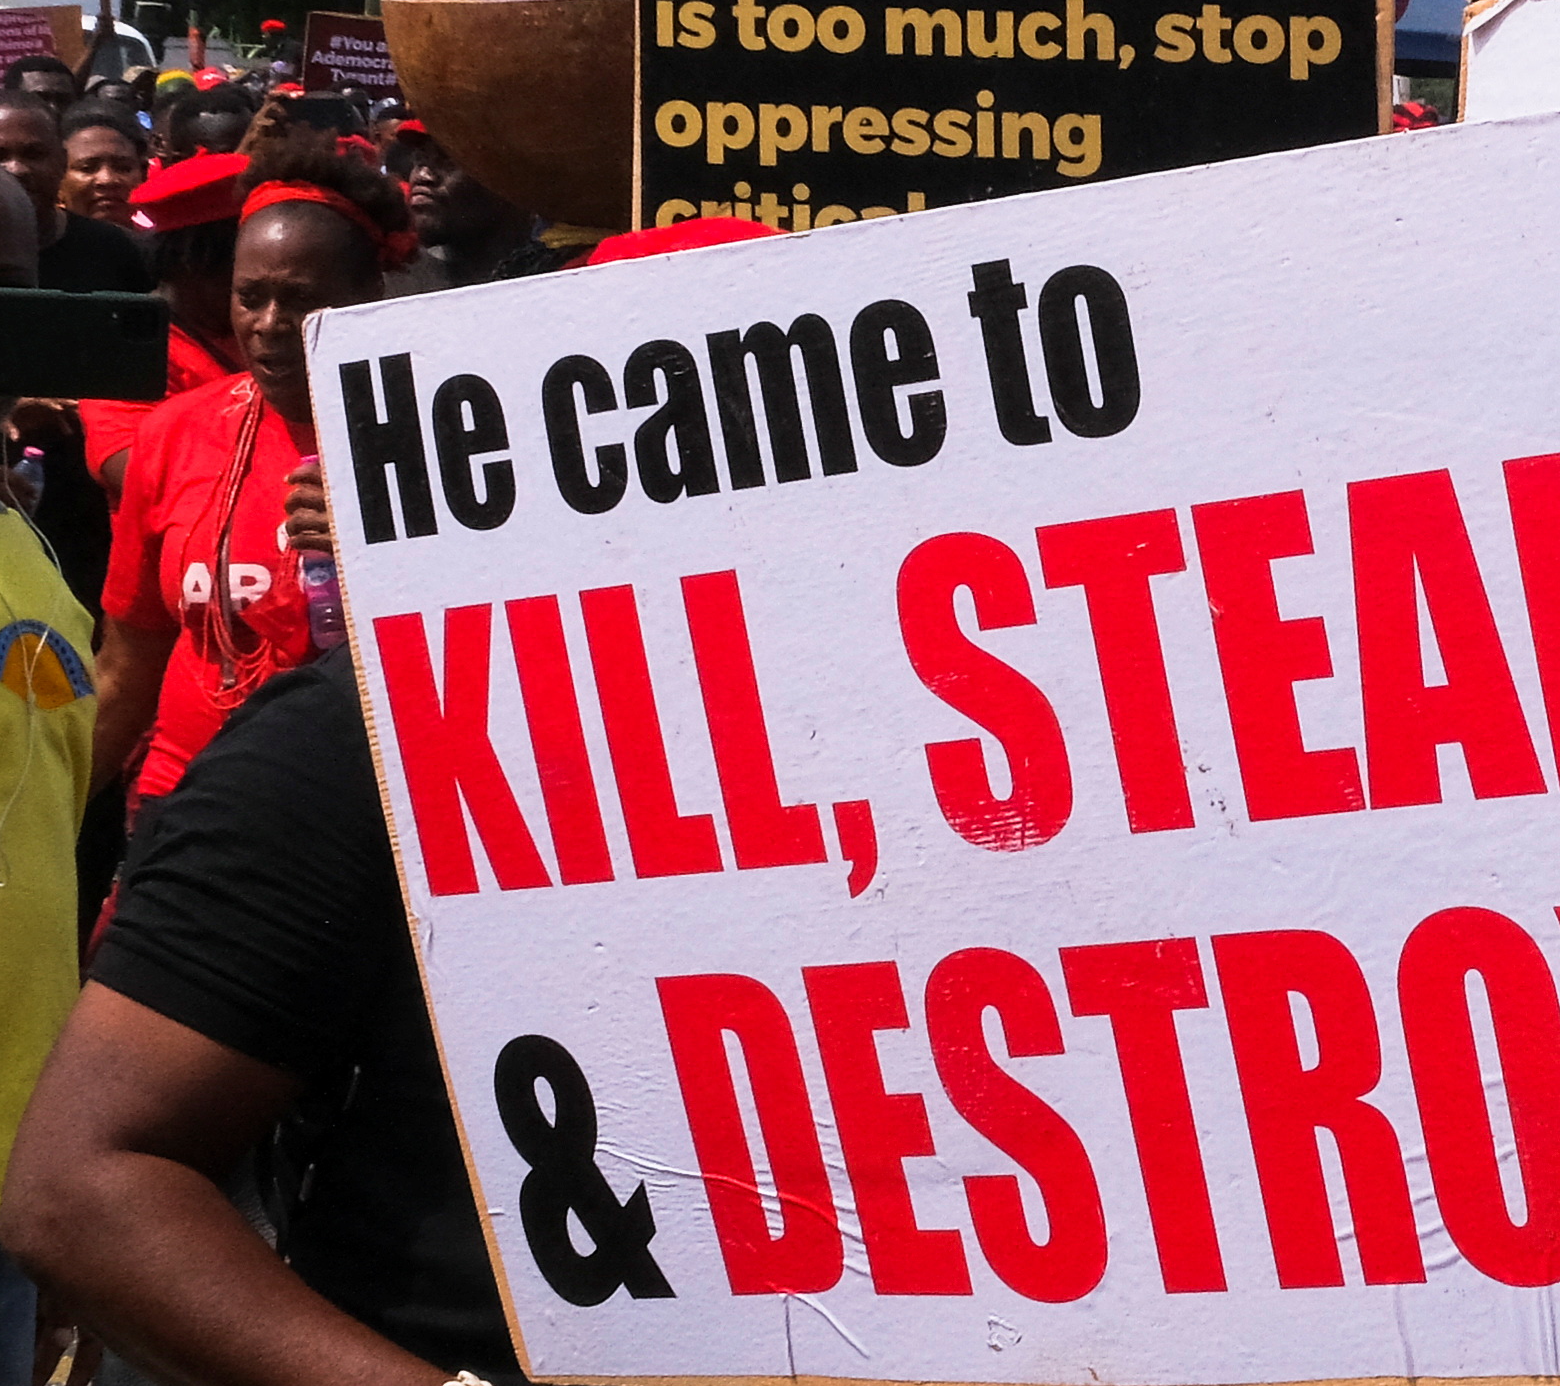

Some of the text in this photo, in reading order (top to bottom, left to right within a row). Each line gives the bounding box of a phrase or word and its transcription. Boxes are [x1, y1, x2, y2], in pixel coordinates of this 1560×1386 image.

[655, 90, 1102, 177] oppressing
[1154, 5, 1341, 80] stop
[655, 180, 927, 232] citic
[339, 259, 1140, 544] He came to
[373, 570, 877, 897] KILL,
[486, 1035, 676, 1314] &
